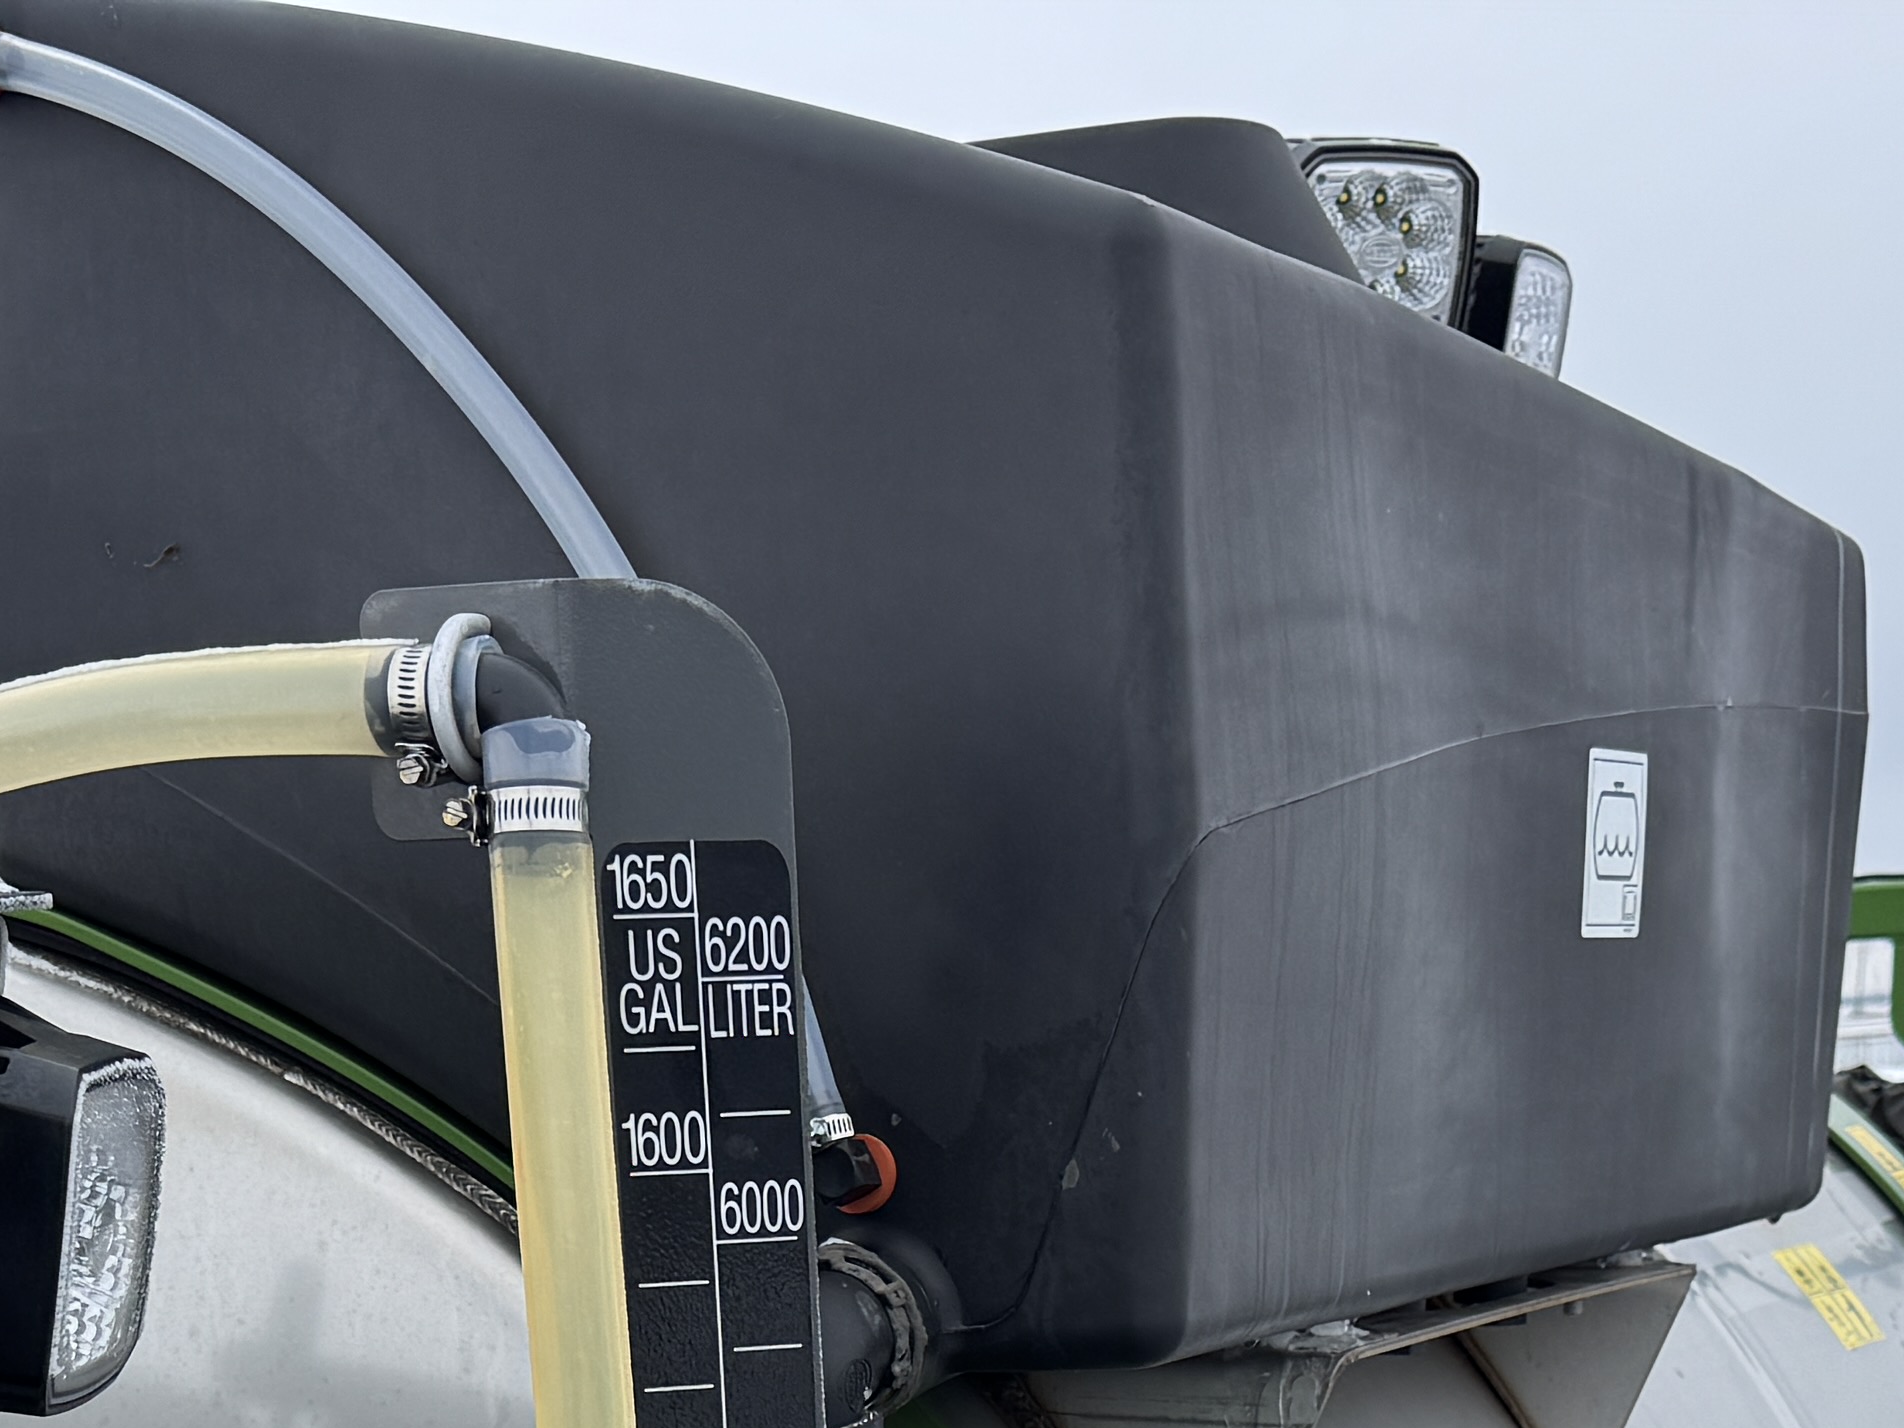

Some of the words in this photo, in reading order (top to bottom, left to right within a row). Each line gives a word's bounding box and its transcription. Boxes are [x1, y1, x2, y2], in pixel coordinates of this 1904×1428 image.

[607, 853, 693, 910] 1650
[627, 928, 683, 982] US
[705, 916, 791, 973] 6200
[620, 982, 699, 1034] GAL
[708, 982, 794, 1038] LITER
[622, 1111, 707, 1168] 1600
[720, 1178, 804, 1234] 6000
